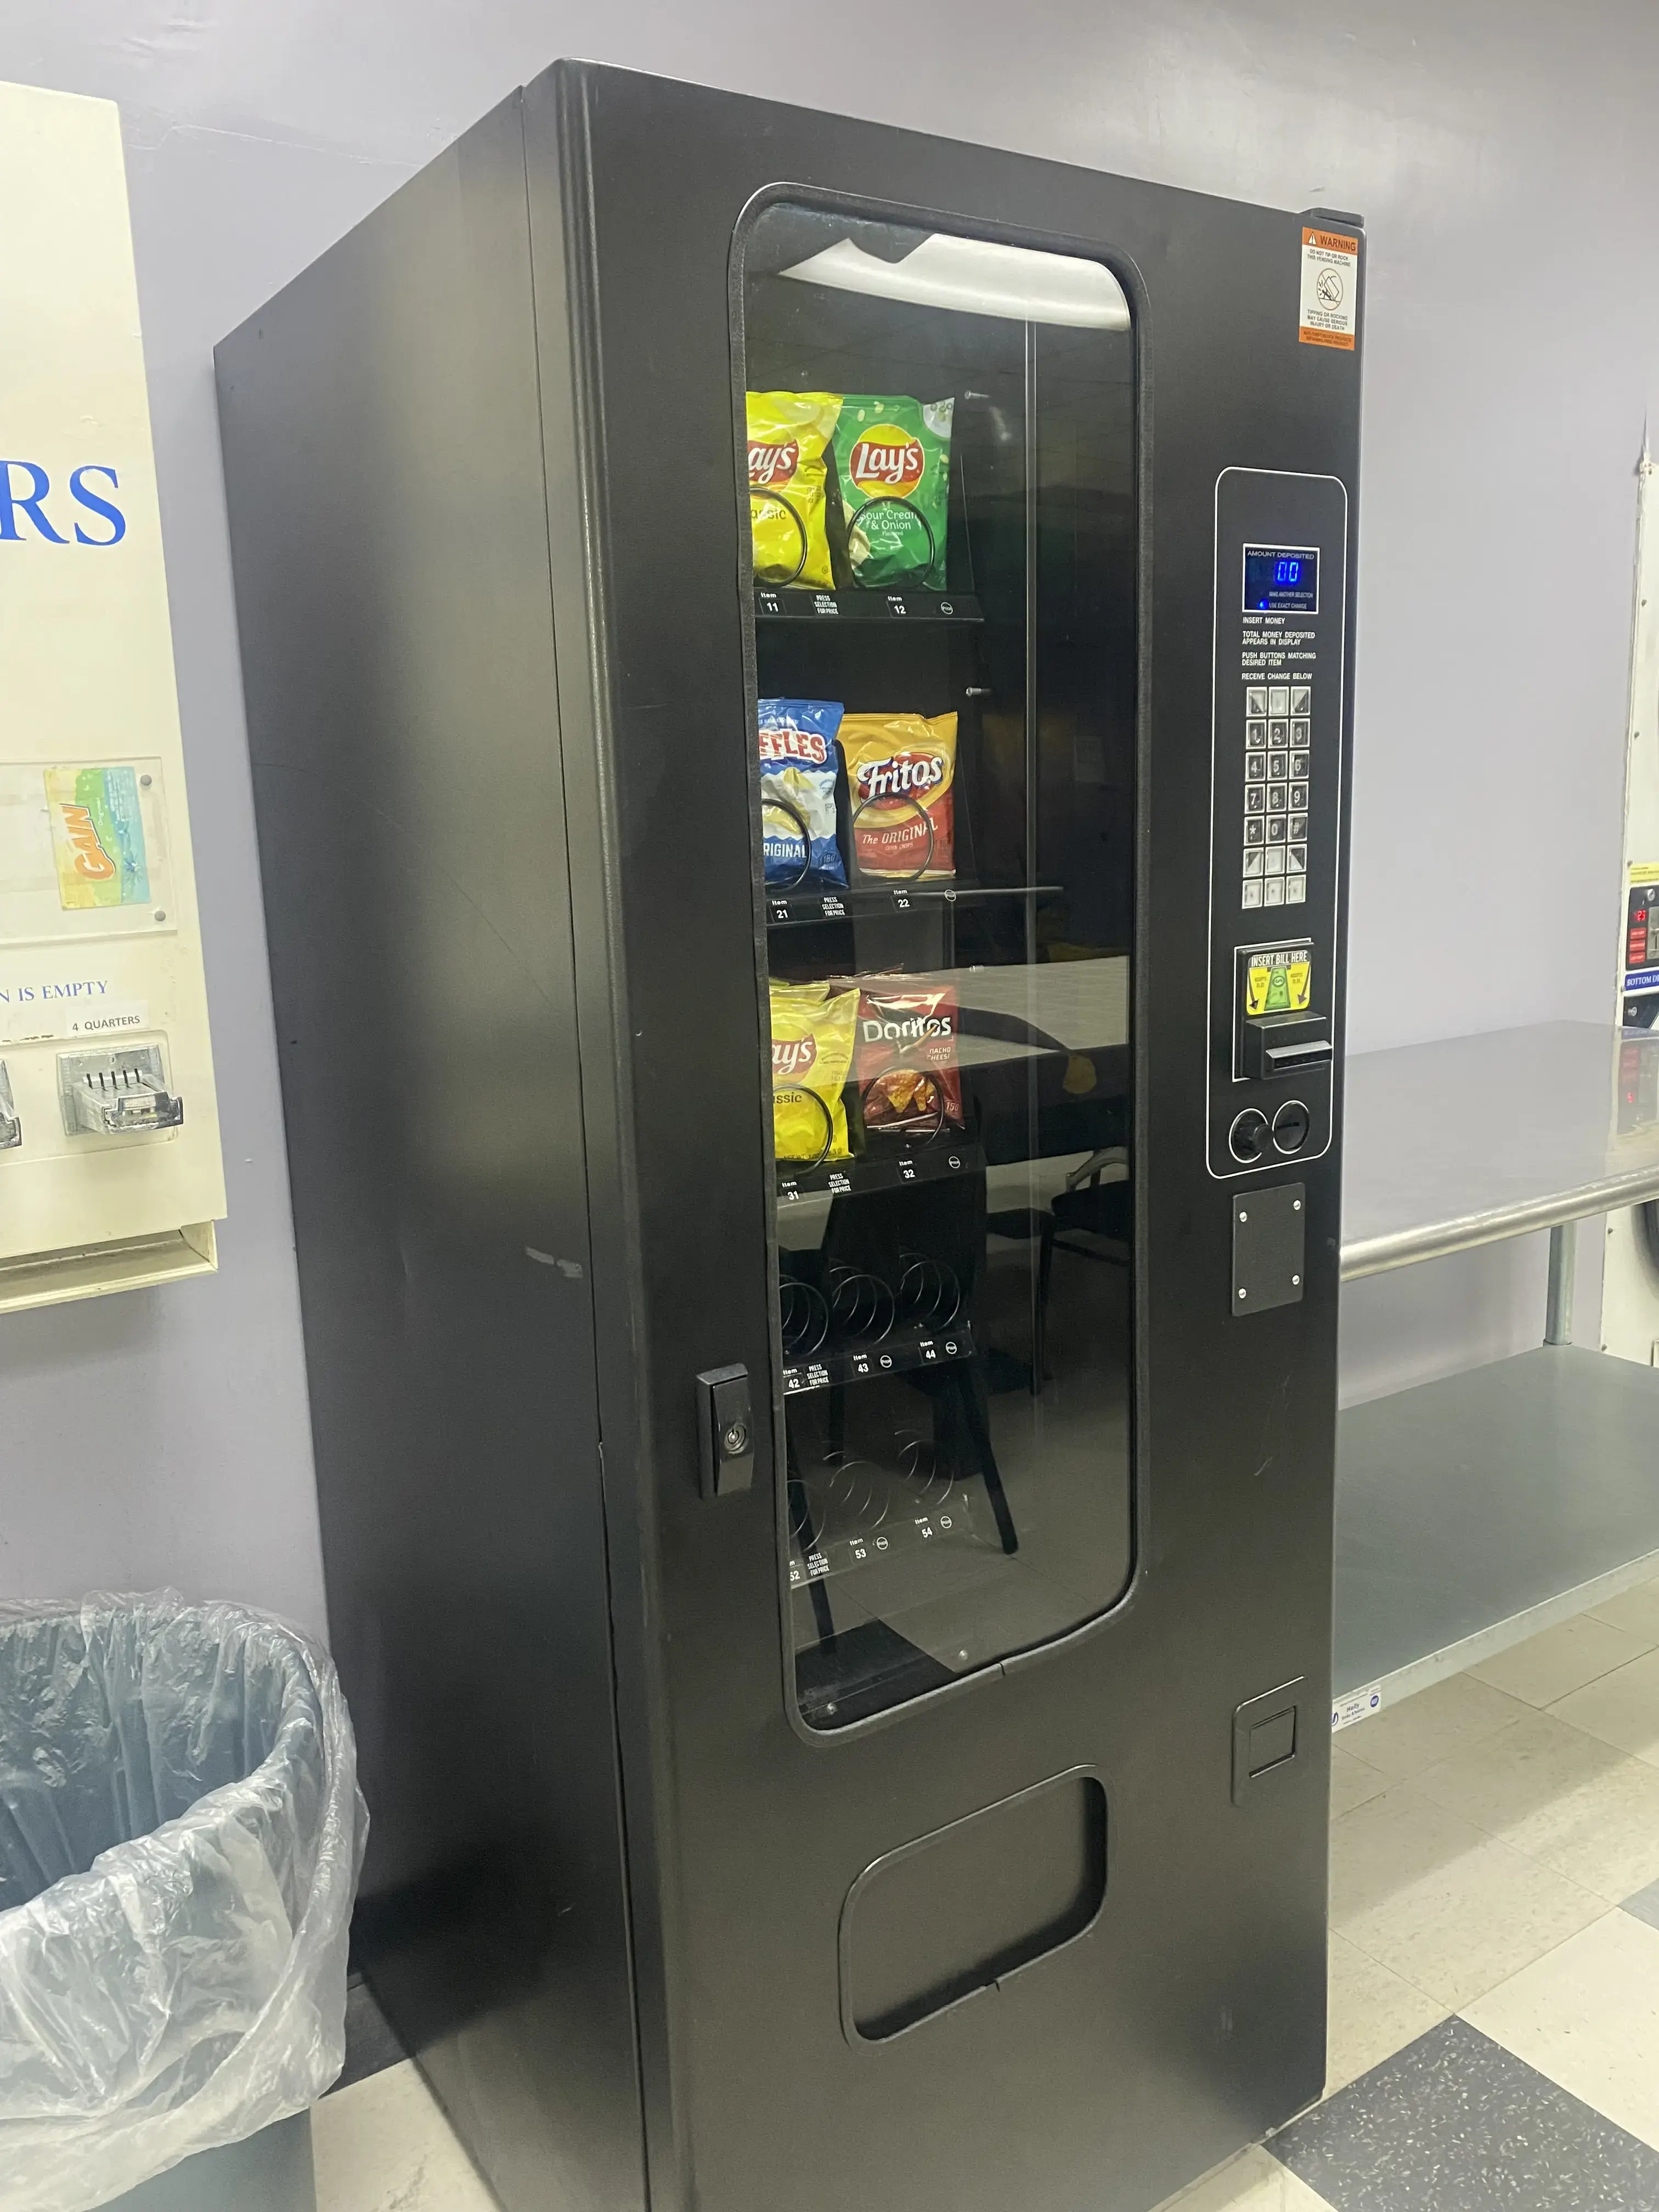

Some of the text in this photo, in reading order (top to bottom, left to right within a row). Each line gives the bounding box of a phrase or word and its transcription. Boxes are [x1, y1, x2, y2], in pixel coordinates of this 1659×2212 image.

[1320, 235, 1356, 251] WARNING
[748, 443, 795, 484] ay's
[856, 442, 918, 484] Lay's
[0, 460, 126, 546] RS
[751, 506, 786, 520] asic
[871, 520, 911, 530] & Onion
[767, 602, 778, 612] 11
[894, 605, 906, 614] 12
[1252, 727, 1302, 741] 1 2 3
[759, 731, 825, 761] FFLES
[1251, 759, 1301, 773] 4 5 6
[857, 757, 943, 802] Fritos
[1251, 791, 1300, 805] 7 8 9
[1271, 823, 1278, 836] 0
[60, 804, 115, 880] GAIN
[862, 834, 878, 844] The
[763, 843, 807, 858] RIGINAL
[898, 899, 910, 907] 22
[776, 909, 788, 918] 21
[1251, 951, 1307, 967] INSERT BILL HERE
[1627, 975, 1651, 986] BOTTOM
[19, 987, 35, 1001] IS
[42, 980, 109, 999] EMPTY
[72, 1015, 140, 1031] 4 QUARTERS
[862, 1017, 951, 1042] Doritos
[774, 1092, 802, 1104] ssic
[903, 1169, 915, 1178] 32
[828, 1179, 849, 1187] SELECTION
[787, 1190, 799, 1200] 31
[926, 1350, 936, 1359] 44
[858, 1363, 869, 1373] 43
[806, 1369, 828, 1379] SELECTION
[788, 1378, 800, 1389] 42
[922, 1527, 933, 1538] 54
[809, 1553, 822, 1561] PRESS
[855, 1548, 867, 1559] 53
[808, 1558, 828, 1569] SELECTION
[790, 1570, 800, 1581] 52
